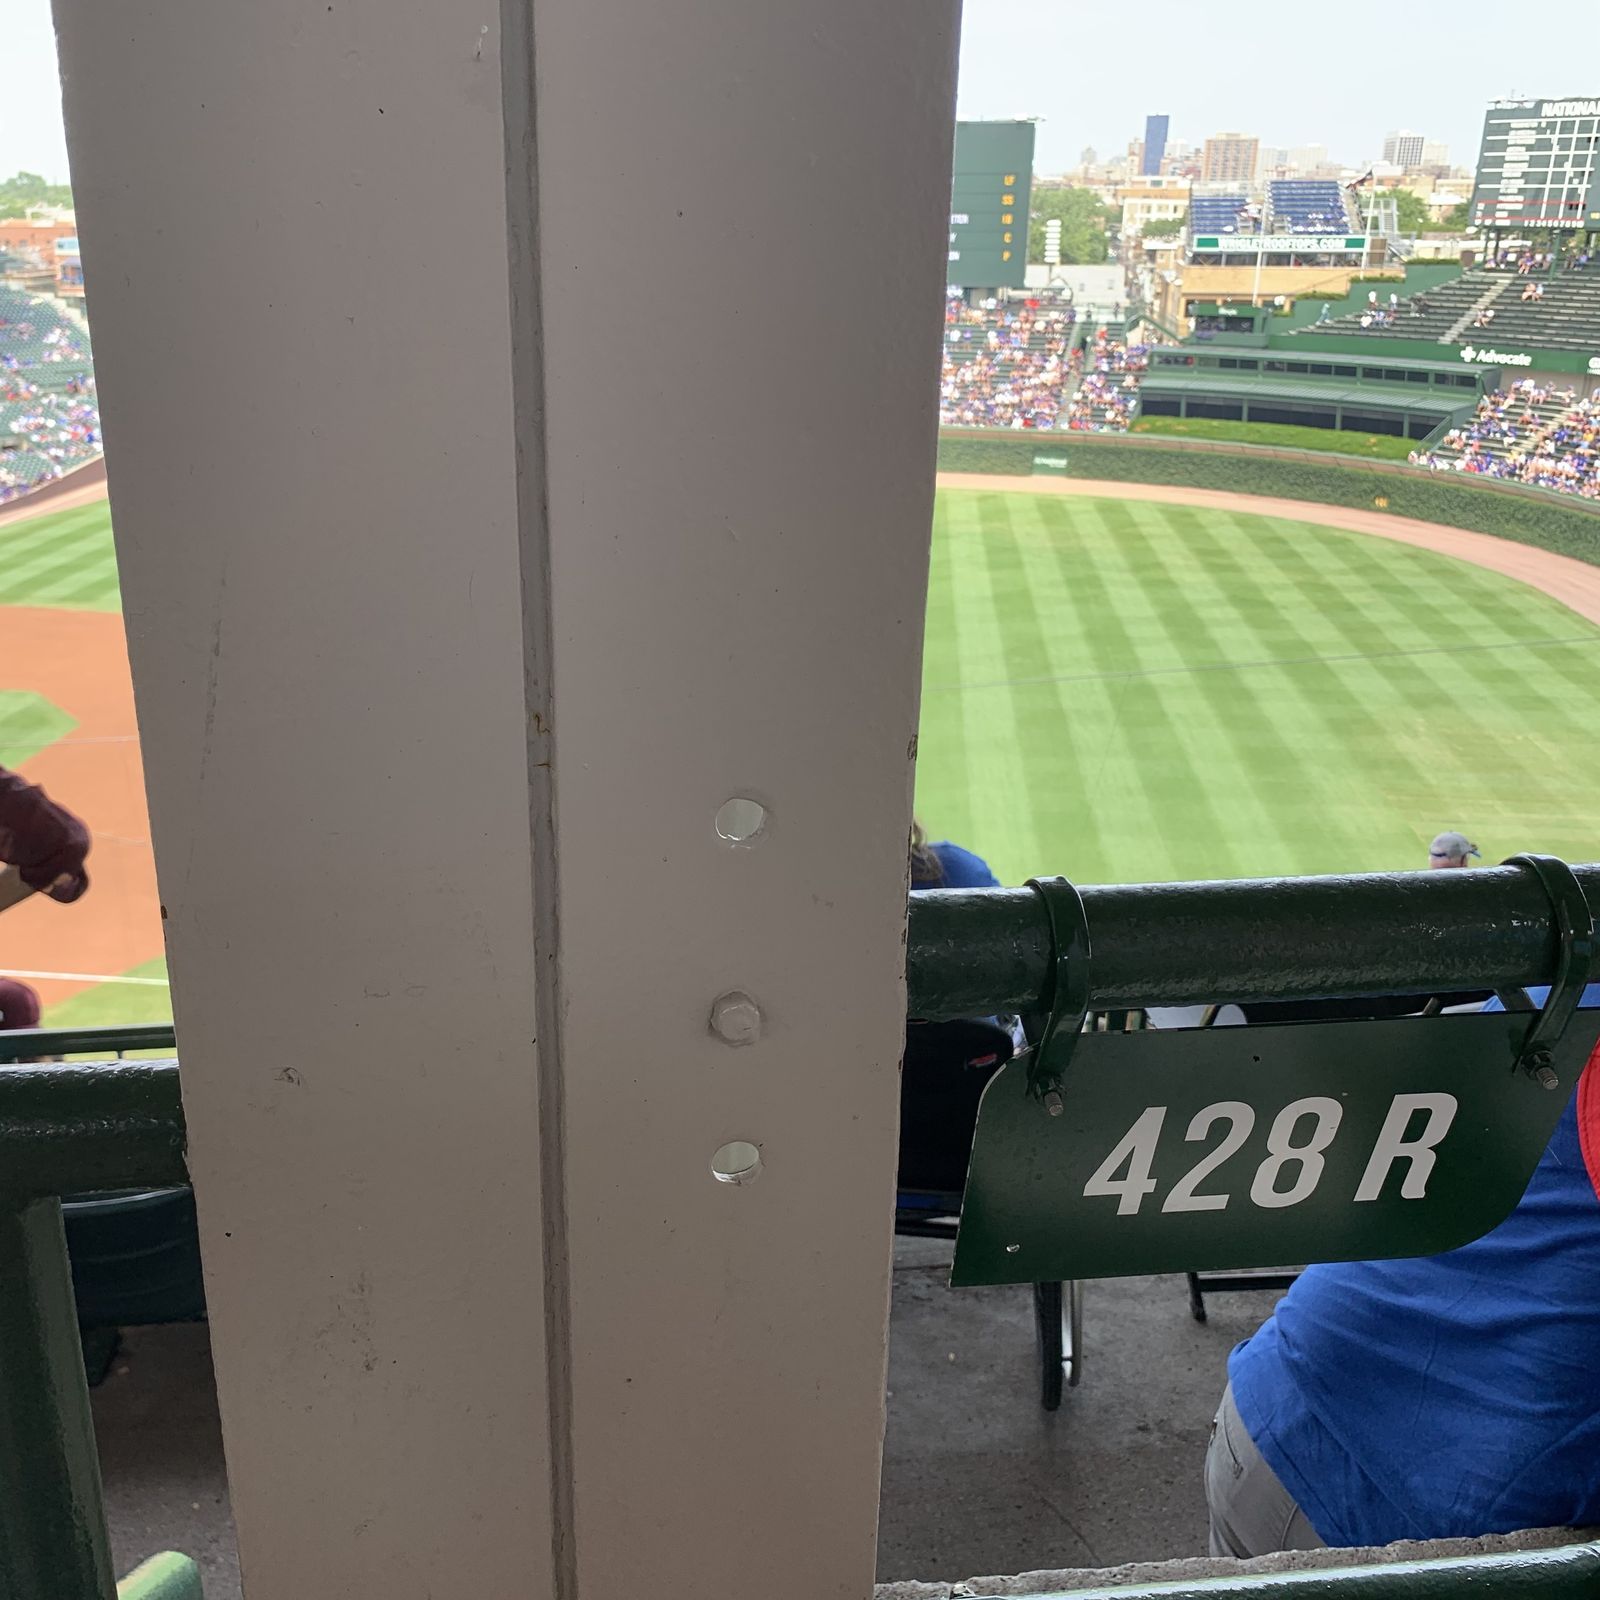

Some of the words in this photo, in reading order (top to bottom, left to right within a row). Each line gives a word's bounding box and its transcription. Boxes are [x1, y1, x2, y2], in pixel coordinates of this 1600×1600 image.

[1476, 349, 1532, 366] Advocate
[1083, 1096, 1343, 1215] 428
[1354, 1092, 1458, 1201] R
